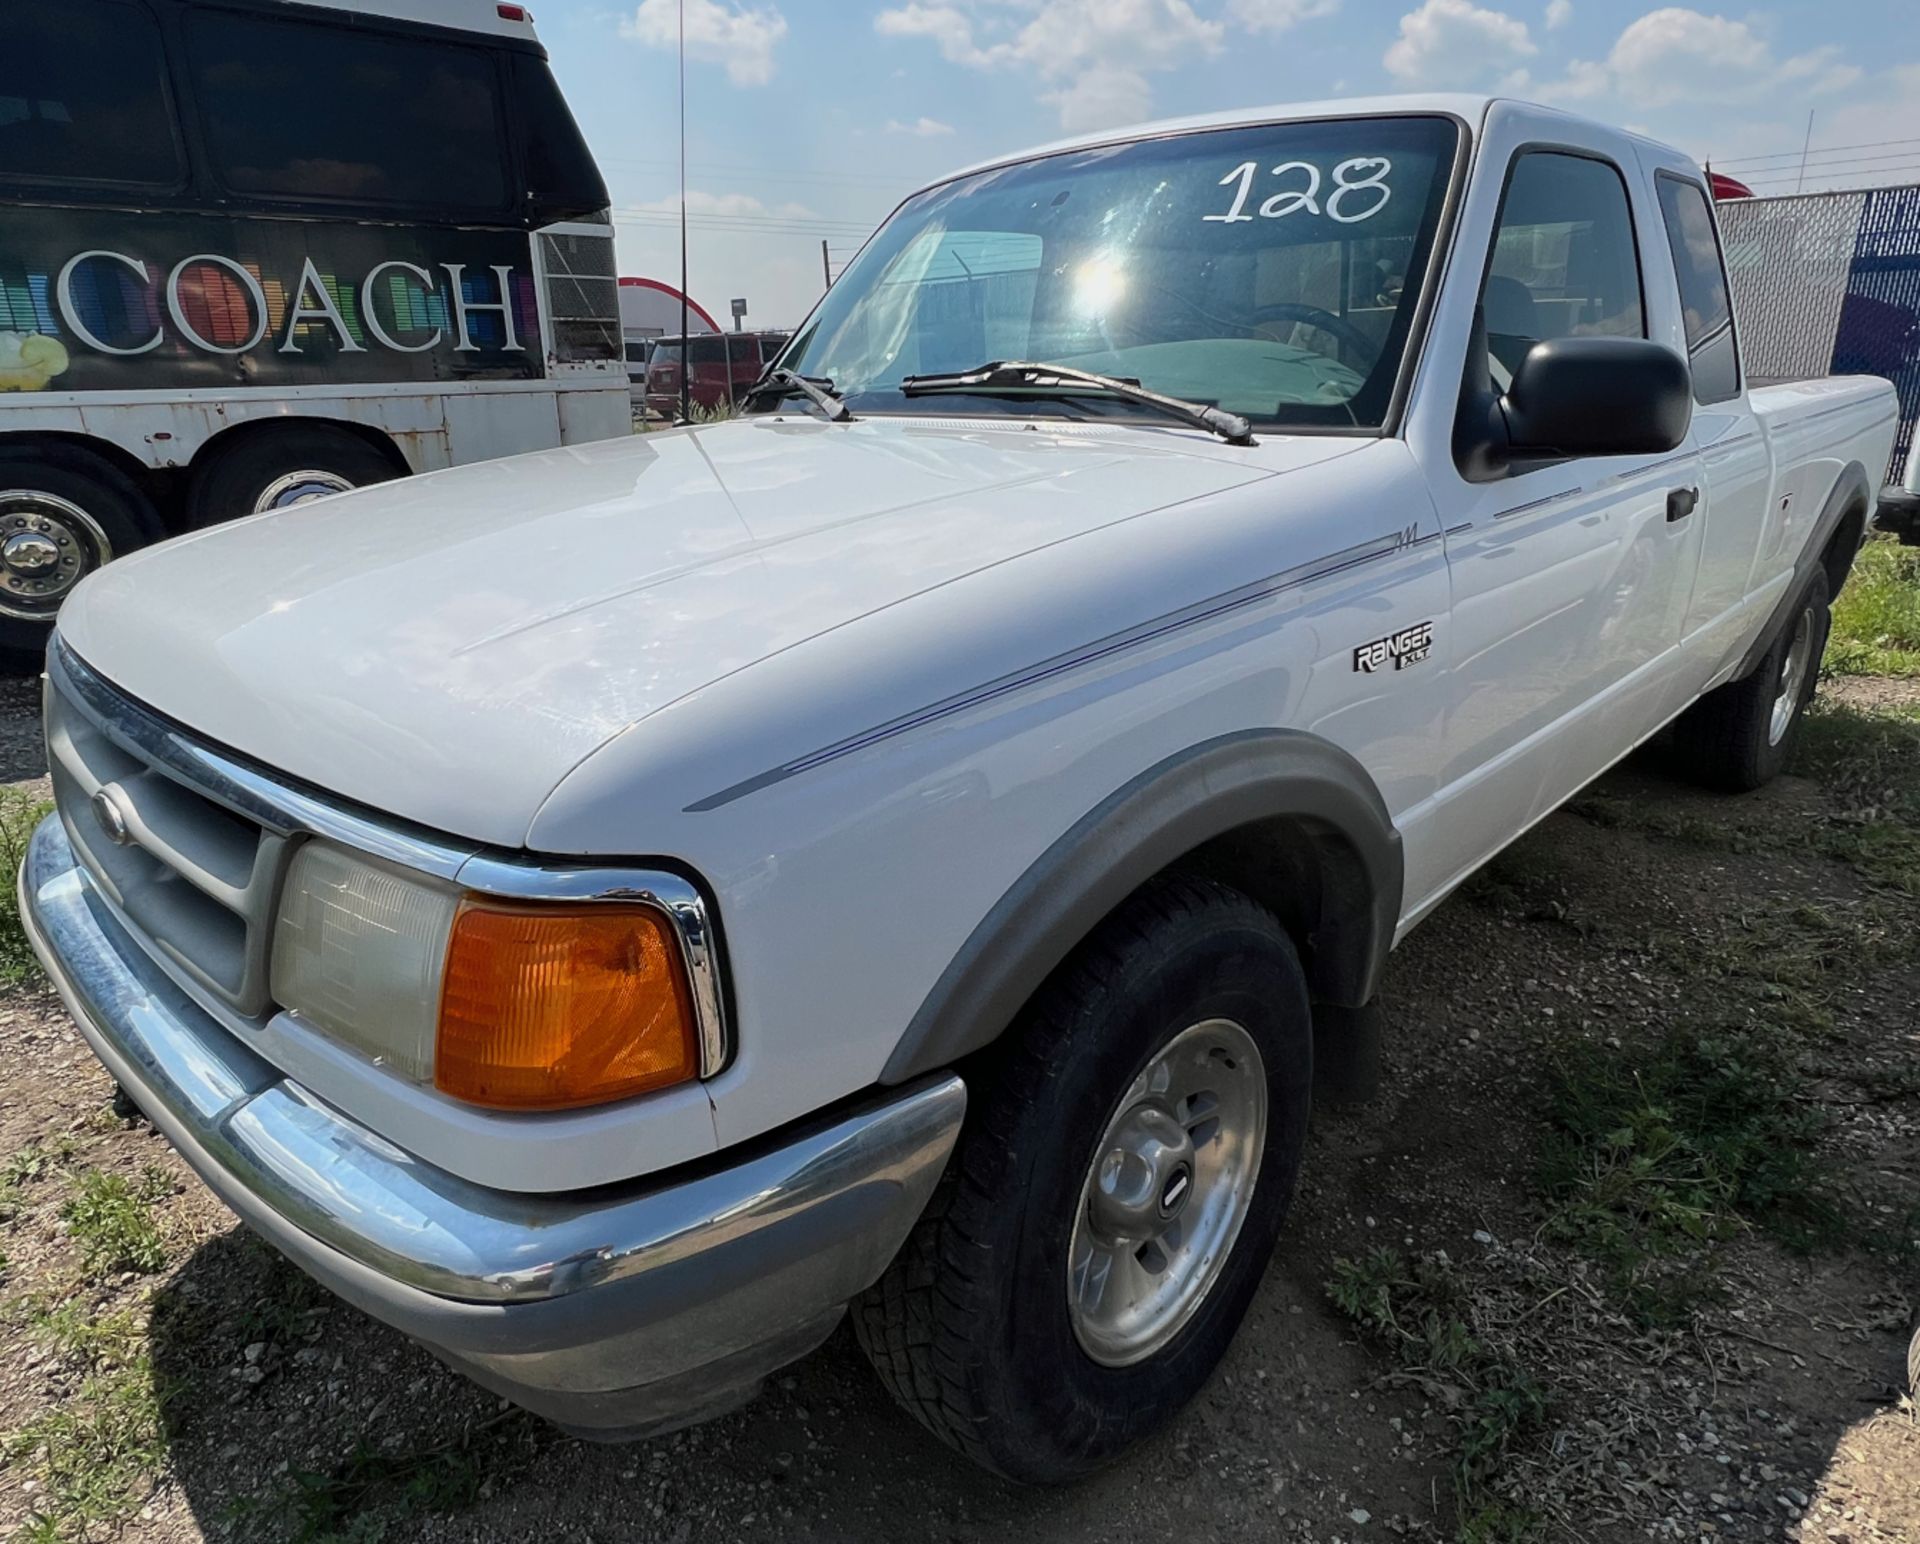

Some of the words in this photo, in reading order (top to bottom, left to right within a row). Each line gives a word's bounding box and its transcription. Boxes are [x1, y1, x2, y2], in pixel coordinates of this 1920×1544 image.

[1202, 157, 1391, 223] 128
[56, 250, 525, 355] COACH
[1403, 647, 1430, 666] XLT
